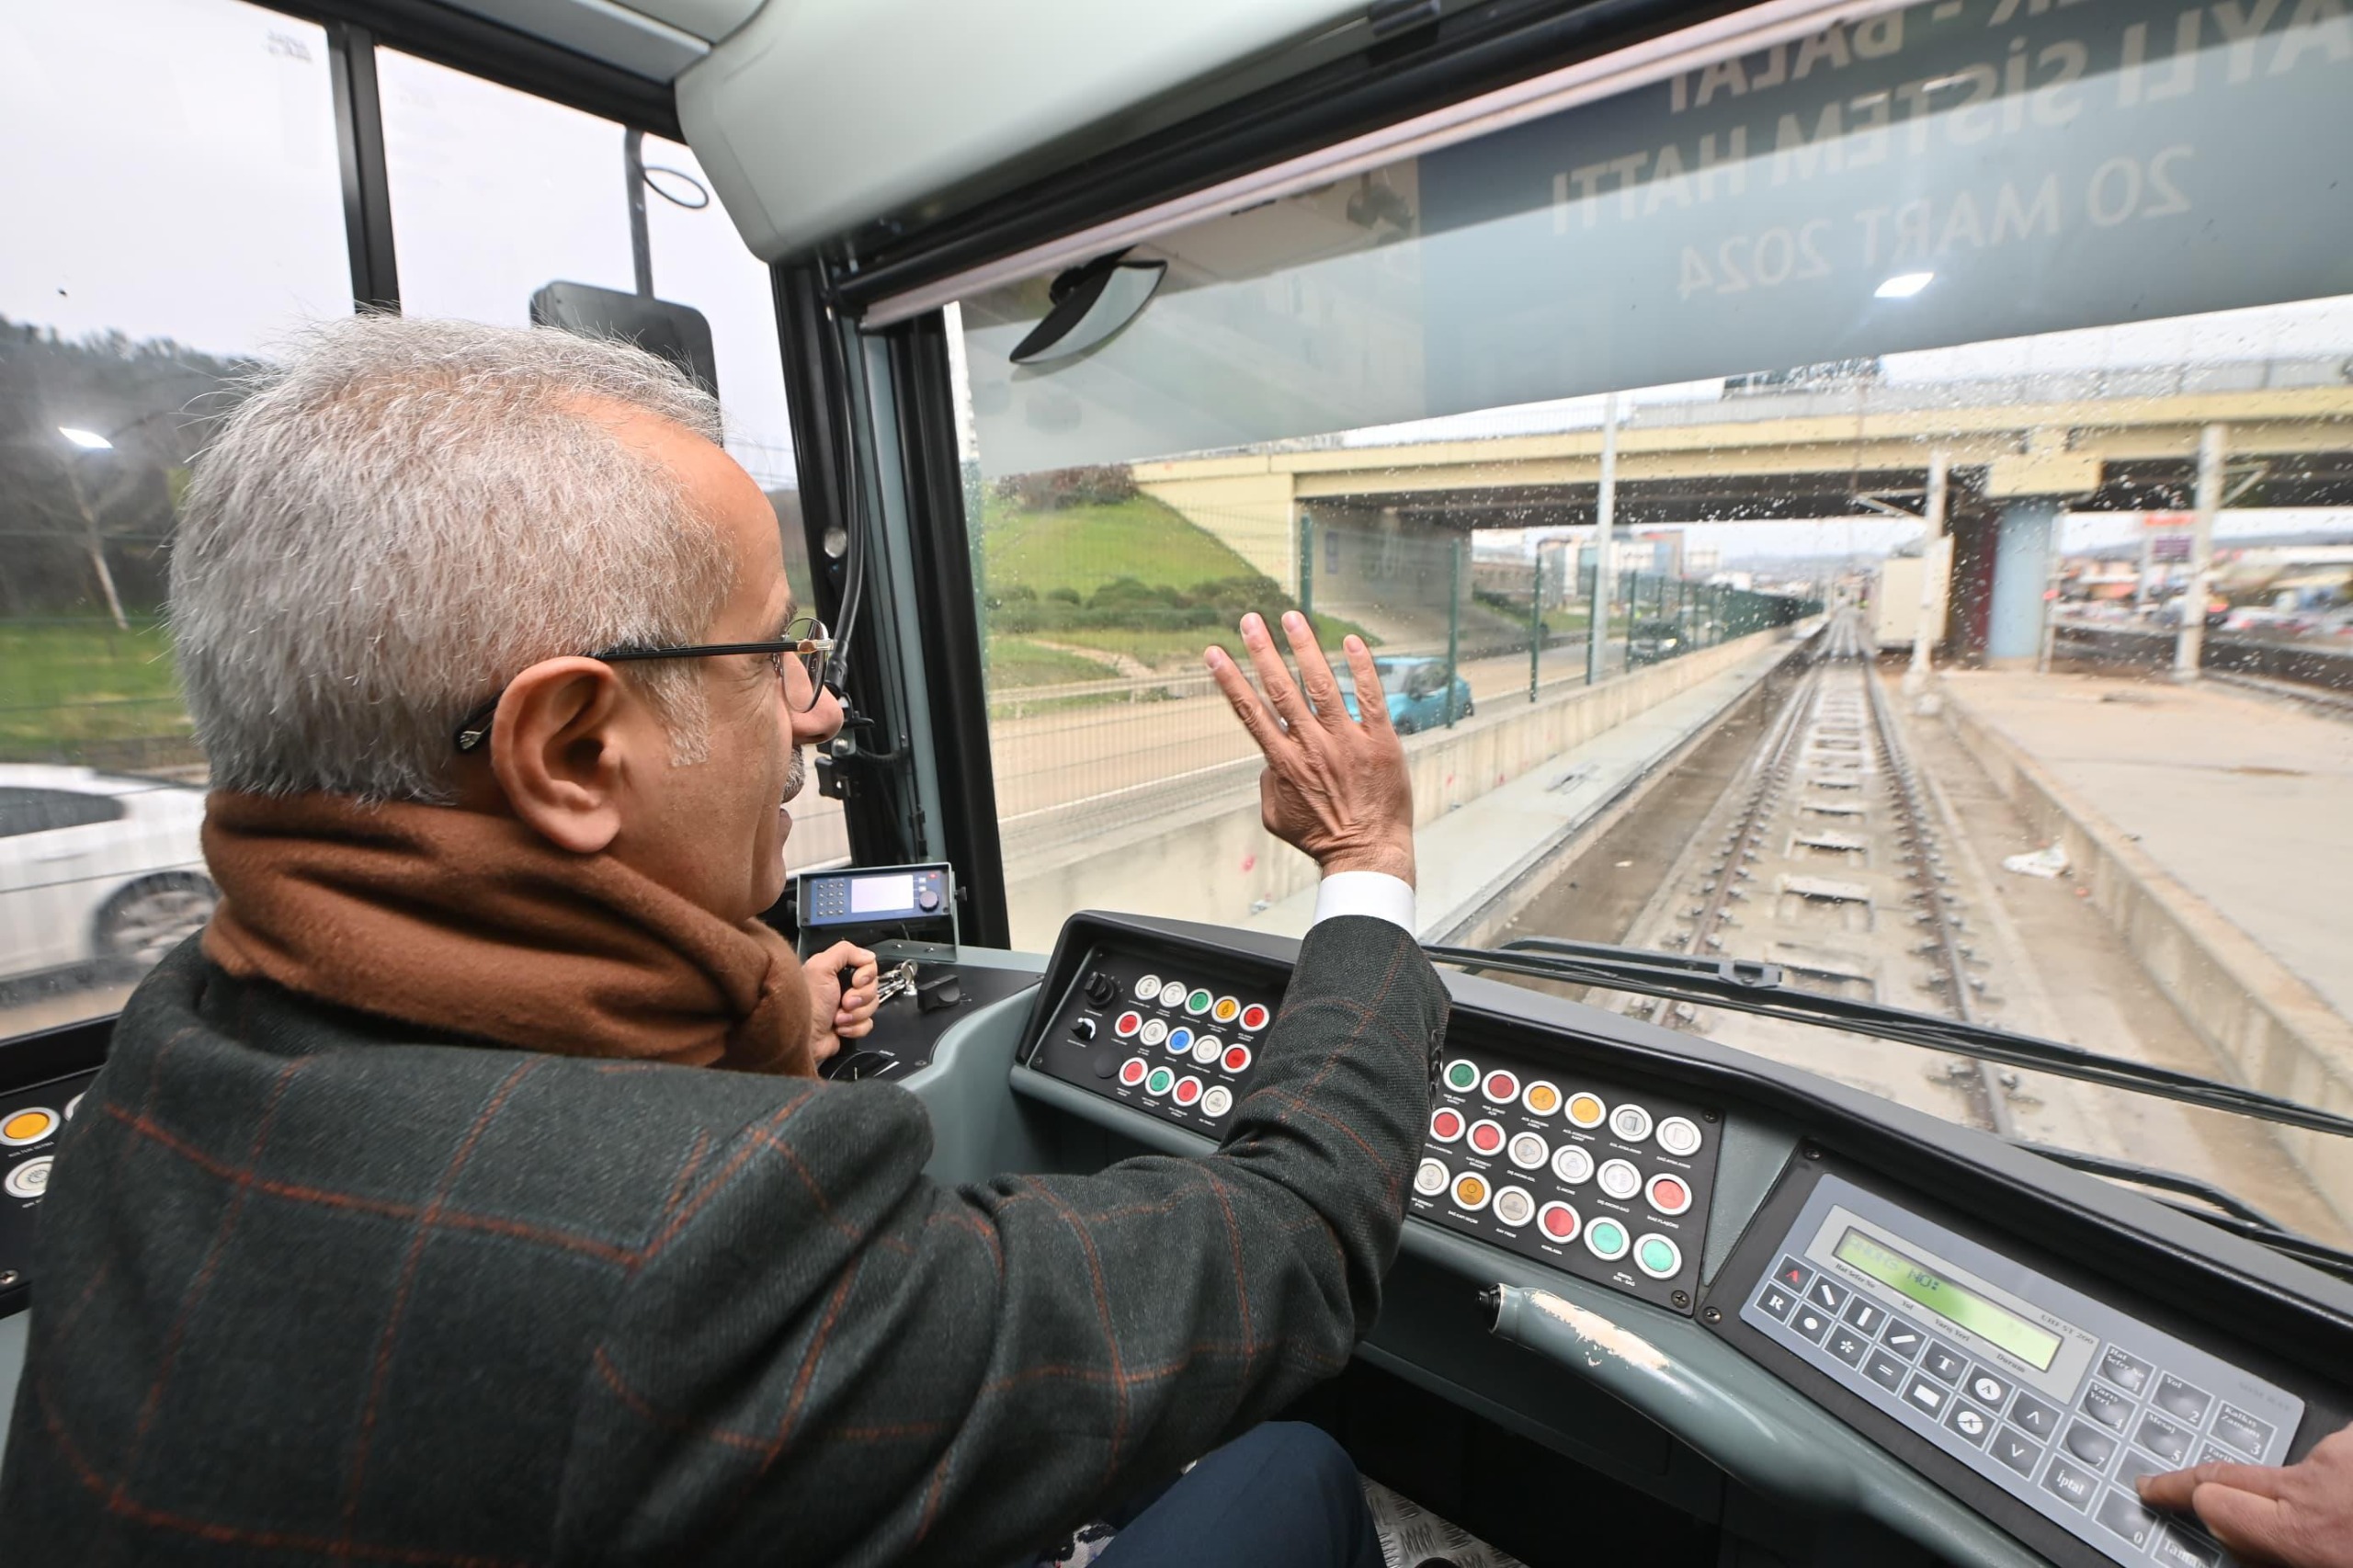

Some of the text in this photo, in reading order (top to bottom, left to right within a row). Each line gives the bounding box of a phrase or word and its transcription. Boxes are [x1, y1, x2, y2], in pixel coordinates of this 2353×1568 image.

[1785, 1269, 1800, 1283] A
[1768, 1294, 1785, 1312] R
[2109, 1347, 2128, 1361] Hat
[1938, 1354, 1955, 1371] T
[2166, 1377, 2183, 1389] Yol
[1981, 1385, 1993, 1396] A
[2115, 1418, 2123, 1429] 4
[2188, 1411, 2200, 1423] 2
[2148, 1414, 2177, 1434] Mesaj
[2170, 1449, 2182, 1461] 5
[2250, 1442, 2261, 1455] 3
[2096, 1456, 2105, 1467] 7
[2133, 1531, 2143, 1545] 0
